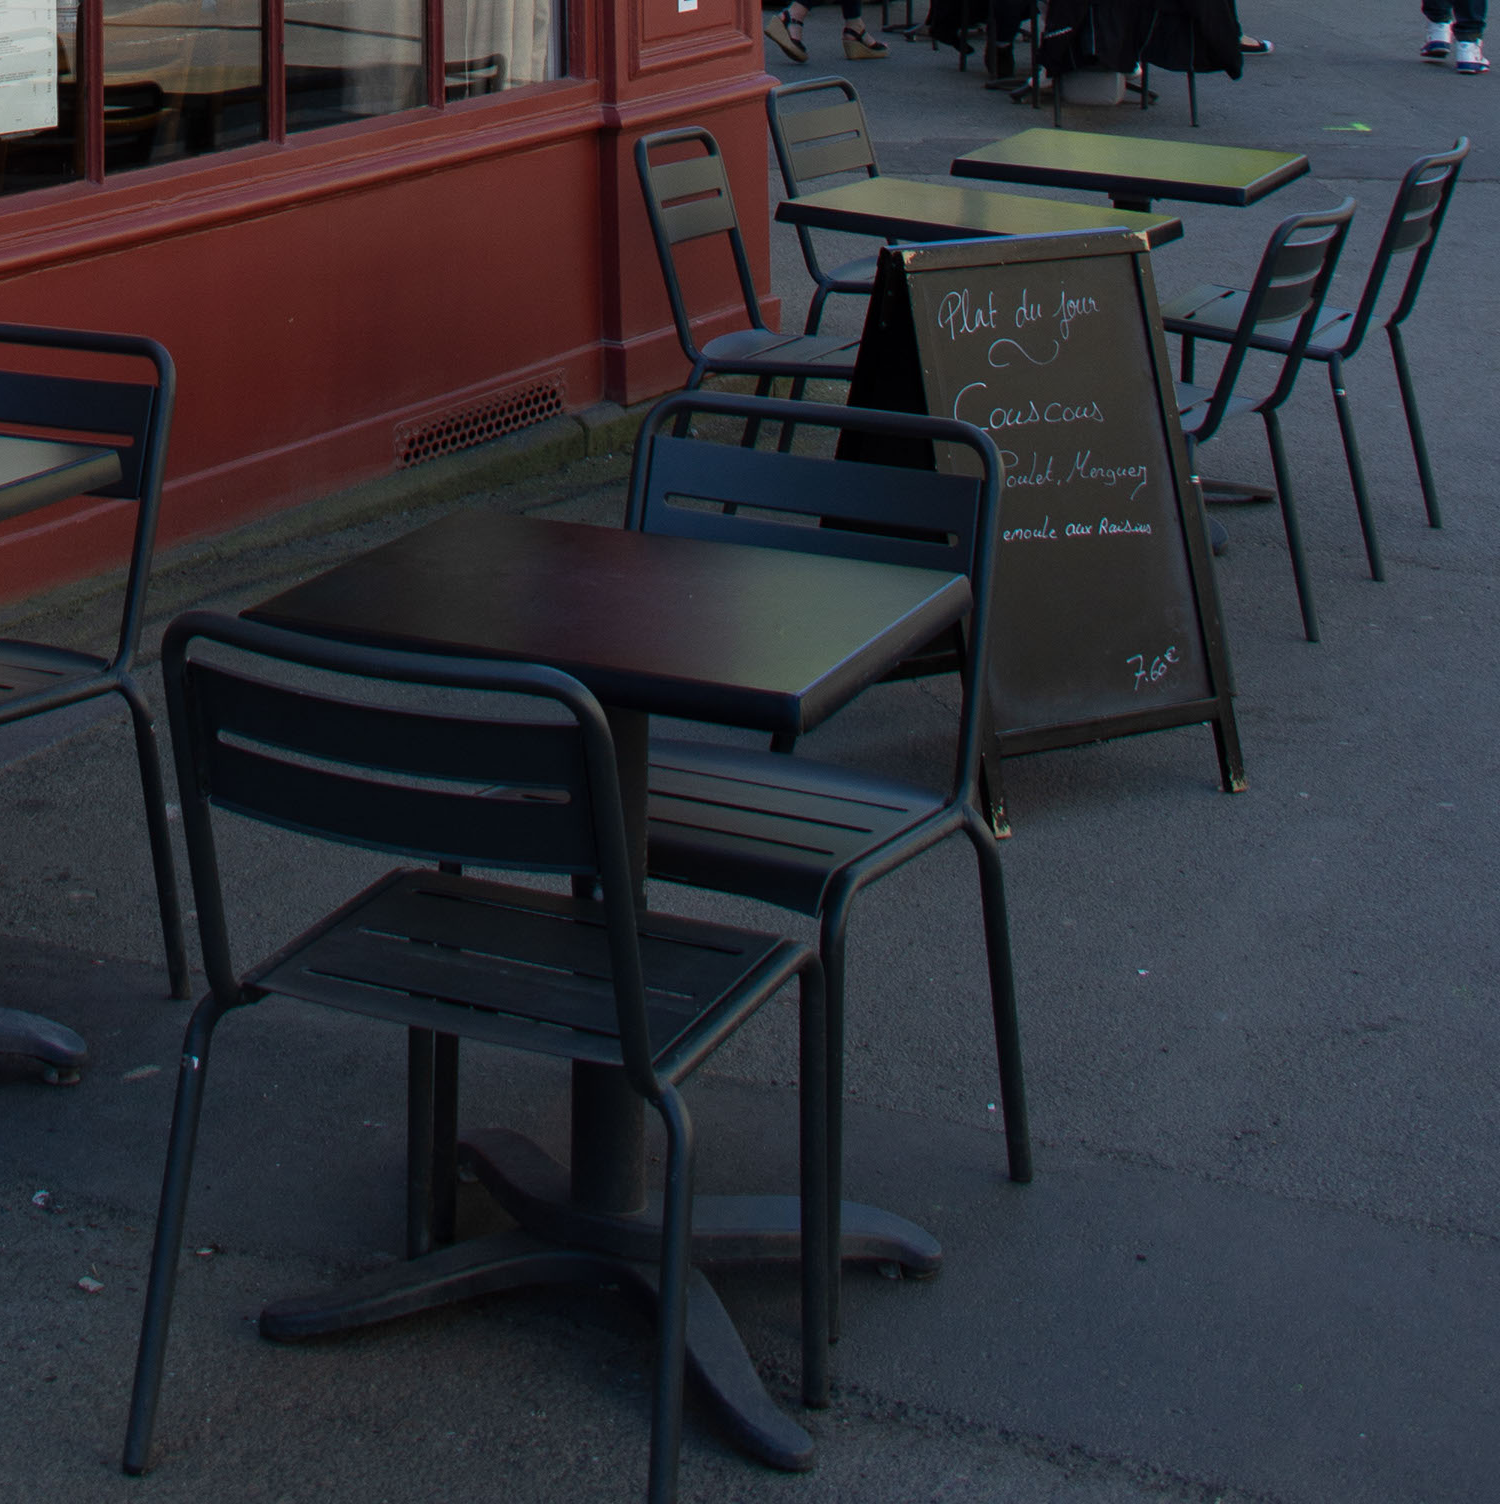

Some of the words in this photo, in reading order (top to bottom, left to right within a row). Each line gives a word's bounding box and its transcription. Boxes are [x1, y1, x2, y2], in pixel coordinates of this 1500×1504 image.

[938, 288, 997, 341] Plat
[1015, 288, 1042, 329] du
[1052, 281, 1101, 340] jour
[954, 381, 1104, 432] Couscous
[1065, 523, 1092, 537] aux
